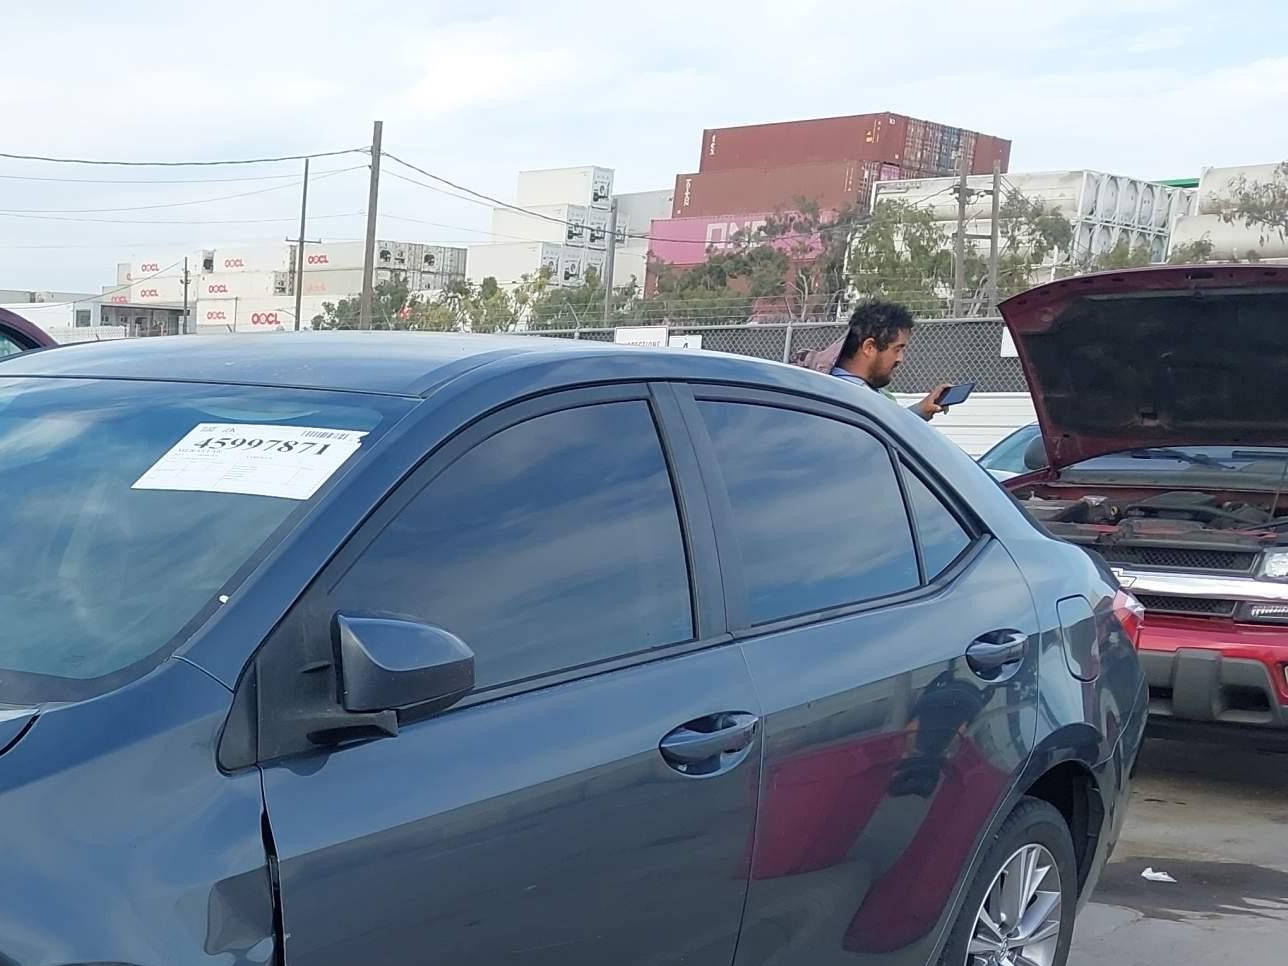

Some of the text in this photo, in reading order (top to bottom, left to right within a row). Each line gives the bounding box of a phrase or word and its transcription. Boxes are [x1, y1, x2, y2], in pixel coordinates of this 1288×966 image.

[224, 259, 244, 268] OOCL
[307, 254, 328, 264] OOCL
[141, 263, 159, 272] OOCL
[208, 284, 228, 293] OOCL
[140, 289, 159, 298] OOCL
[206, 311, 226, 320] OOCL
[251, 312, 280, 325] OOCL
[193, 436, 332, 456] 45997871
